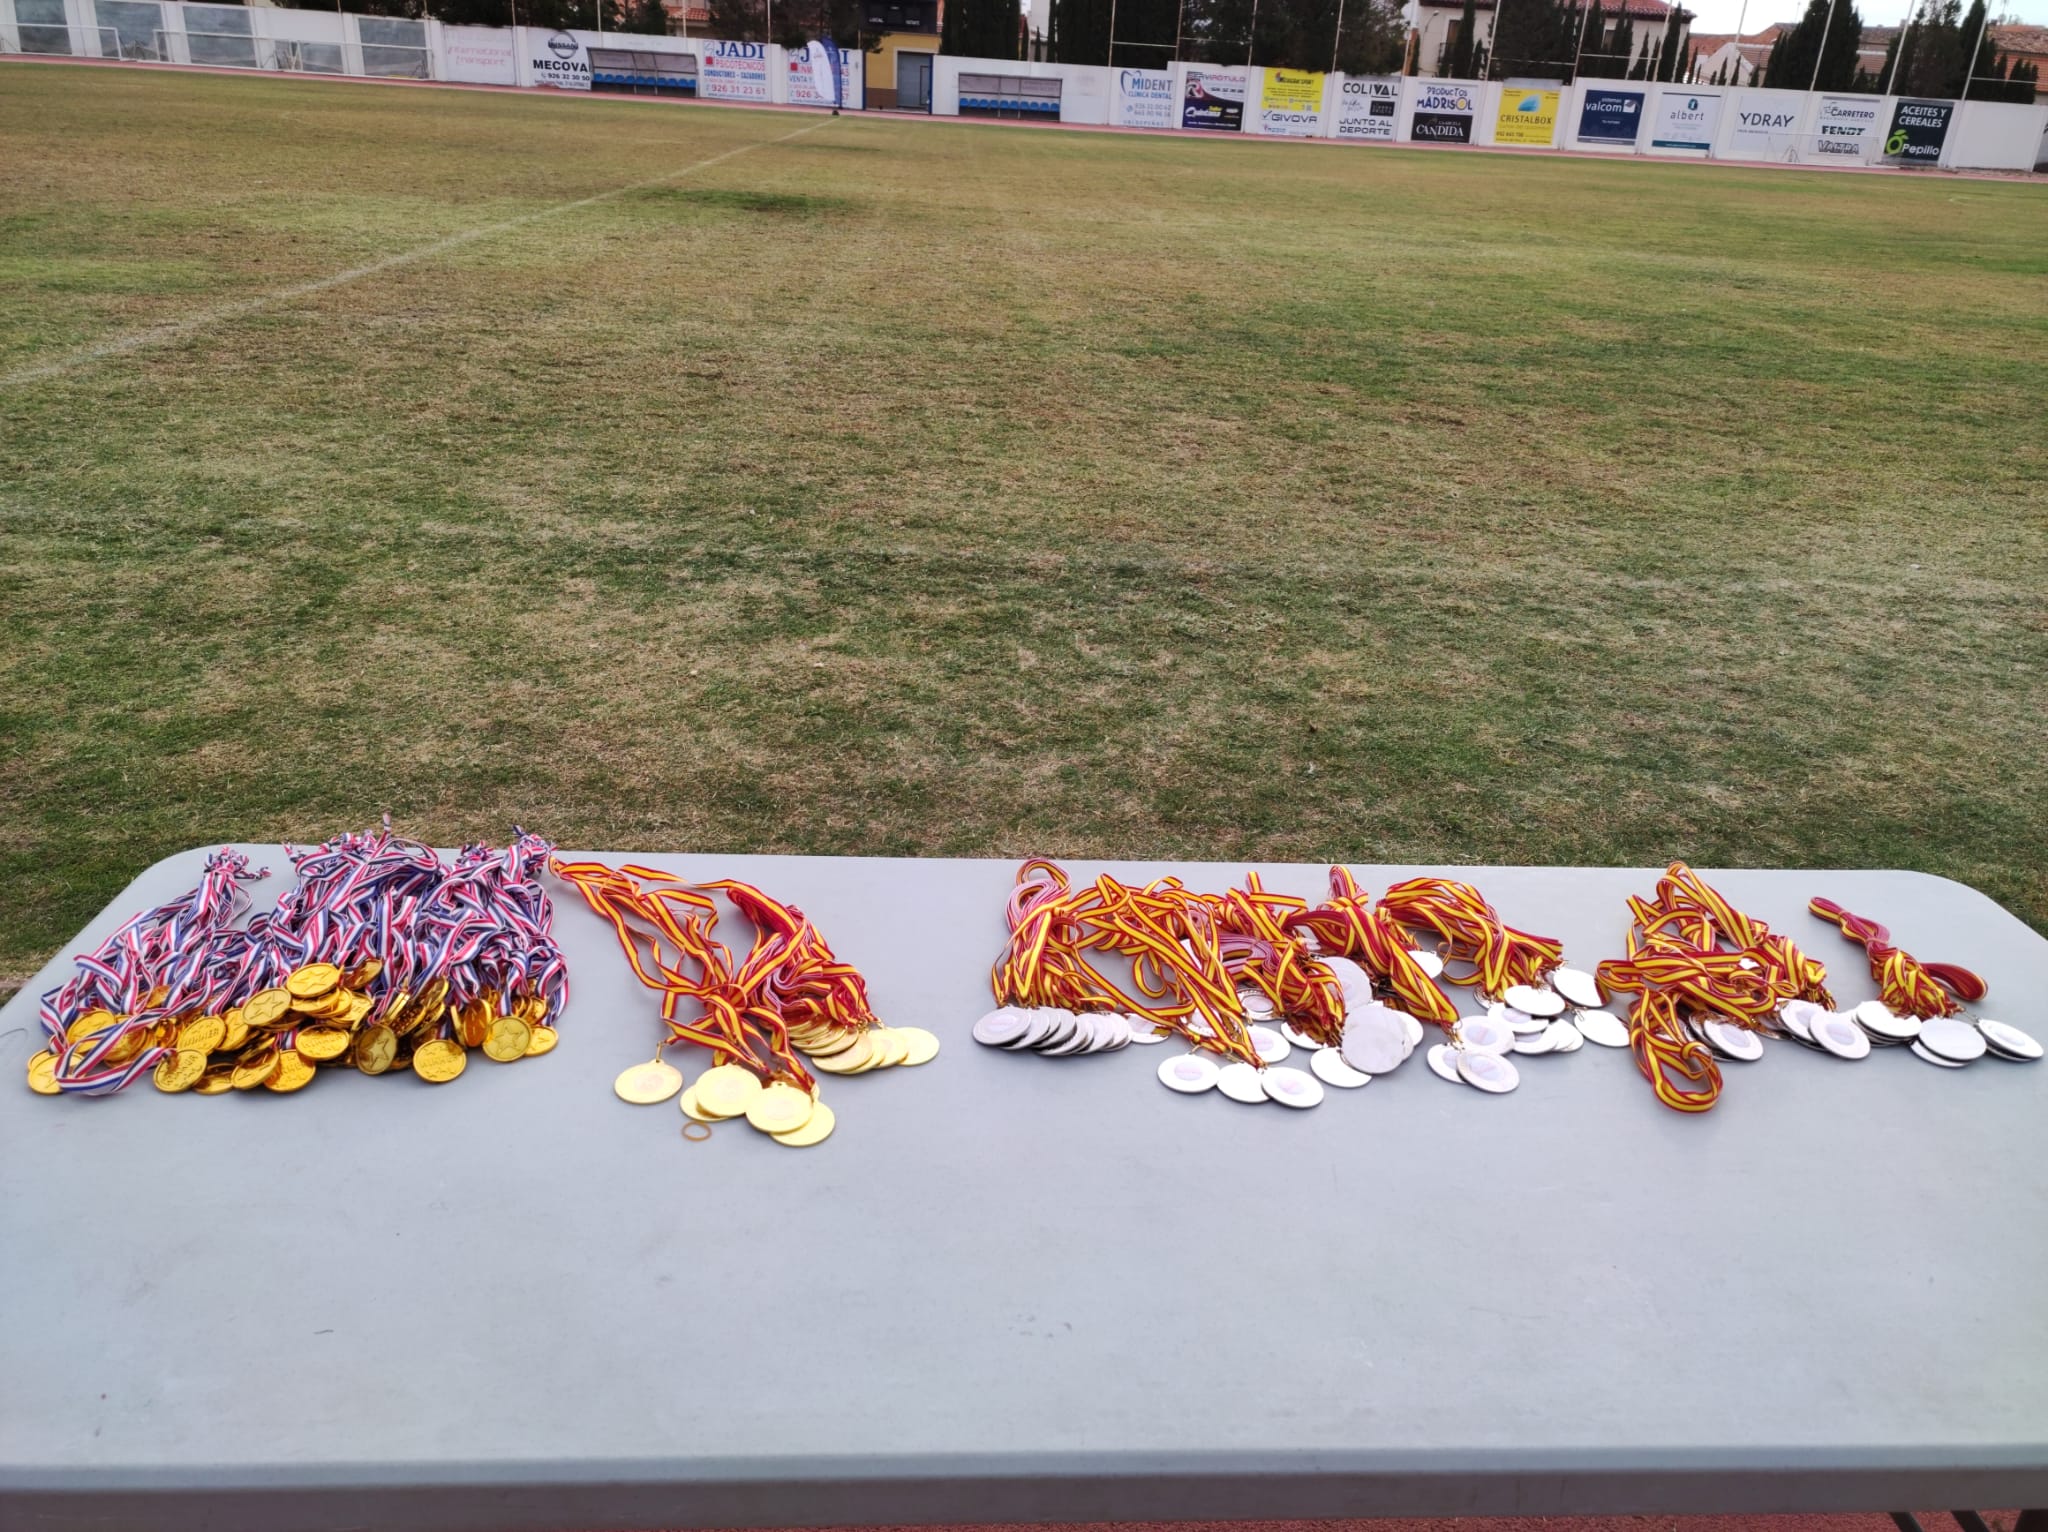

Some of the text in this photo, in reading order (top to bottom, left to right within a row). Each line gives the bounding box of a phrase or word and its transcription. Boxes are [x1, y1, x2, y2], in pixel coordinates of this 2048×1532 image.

[715, 41, 766, 59] JADI
[711, 84, 766, 95] 926 31 23 61
[1132, 78, 1173, 91] MIDENT
[1342, 82, 1398, 97] COLIVAL
[796, 90, 811, 98] 926
[1150, 92, 1172, 100] DENTAL
[1426, 86, 1468, 97] PRODUCTOS
[1416, 96, 1473, 111] MADRISOL
[1586, 101, 1622, 113] valcom
[1670, 110, 1705, 121] albert
[1831, 108, 1875, 119] CARRETERO
[1901, 105, 1948, 117] ACEITES Y
[1271, 113, 1318, 123] GIVOVA
[1339, 119, 1376, 127] JUNTO
[1500, 114, 1552, 125] CRISTALBOX
[1740, 112, 1795, 128] YDRAY
[1898, 116, 1943, 128] CEREALES
[1339, 126, 1391, 135] DEPORTE
[1822, 125, 1866, 136] FENDT
[1818, 140, 1859, 154] VALTRA
[1902, 143, 1940, 156] Pepillo
